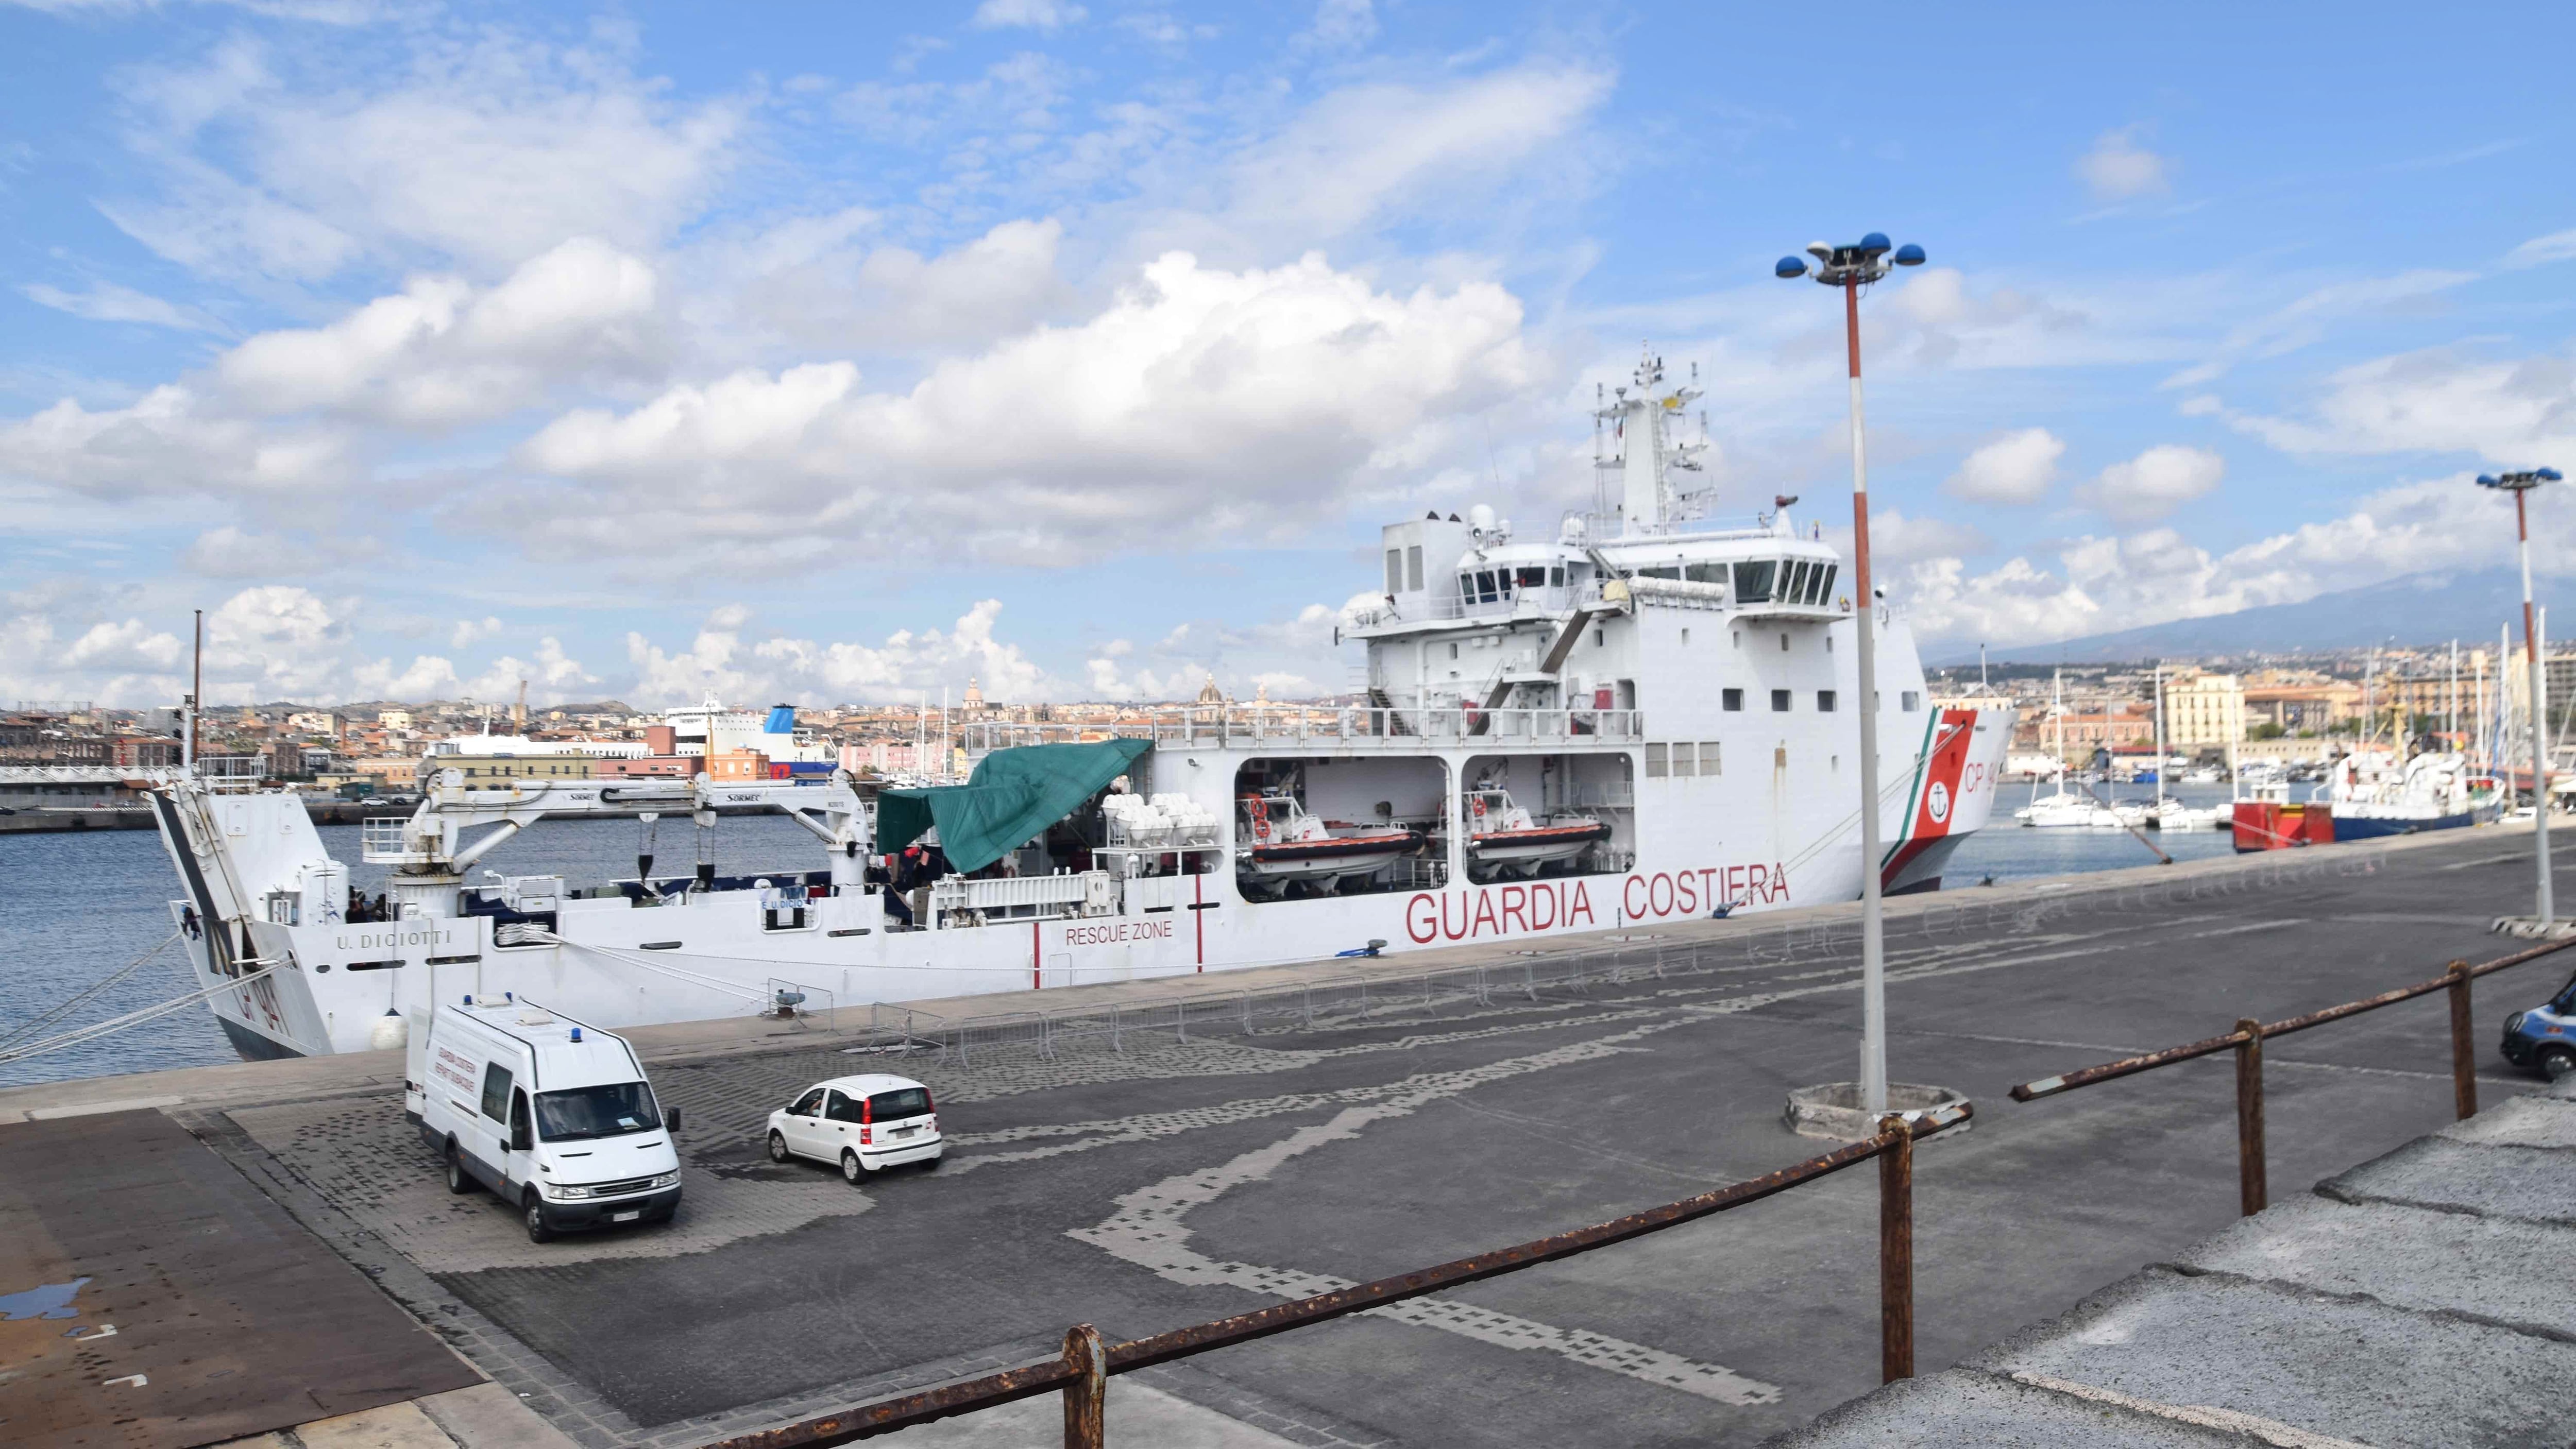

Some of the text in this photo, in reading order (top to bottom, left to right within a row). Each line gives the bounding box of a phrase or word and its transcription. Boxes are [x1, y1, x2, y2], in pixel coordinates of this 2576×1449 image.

[1965, 763, 1984, 792] CP
[1406, 862, 1790, 944] GUARDIA COSTIERA
[336, 930, 451, 950] U. DICIOTTI
[1066, 920, 1172, 946] RESCUE ZONE
